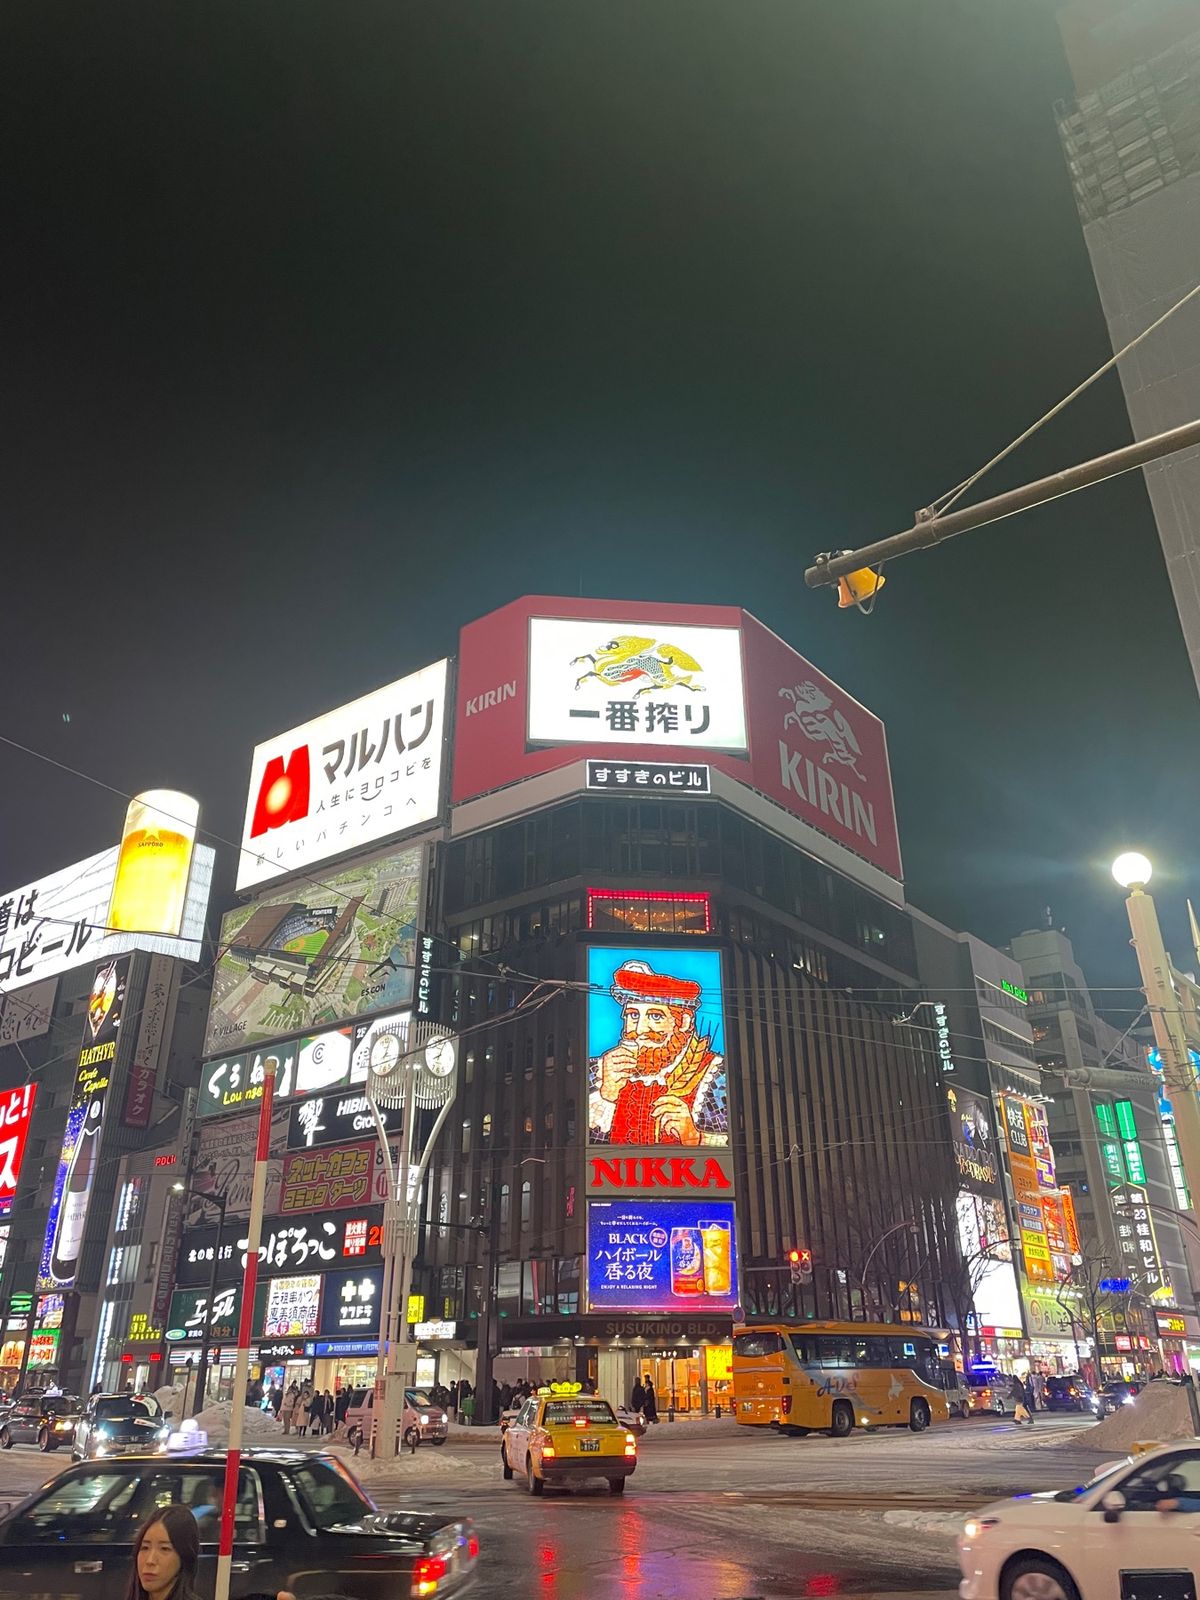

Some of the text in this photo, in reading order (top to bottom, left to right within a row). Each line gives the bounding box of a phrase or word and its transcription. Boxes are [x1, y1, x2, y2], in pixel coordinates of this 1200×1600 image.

[465, 680, 516, 717] KIRIN
[569, 700, 711, 735] 一番搾り
[322, 698, 434, 785] マルハン
[316, 757, 431, 814] 人生にヨロコビを
[595, 768, 702, 788] すすきのビル
[777, 739, 878, 848] KIRIN
[219, 1020, 248, 1036] VILLAGE
[79, 1041, 116, 1067] HATHYR
[131, 1069, 150, 1116] カラオケ
[223, 1087, 263, 1105] Lounge
[1007, 1106, 1025, 1131] 快活
[1010, 1129, 1028, 1147] CLUB
[286, 1149, 370, 1185] ネットカフェ
[590, 1157, 732, 1189] NIKKA
[283, 1185, 329, 1210] コミック
[608, 1233, 649, 1244] BLACK
[595, 1247, 663, 1262] ハイボール
[604, 1262, 655, 1281] 香る夜
[606, 1323, 721, 1336] SUSUKINO BLD.
